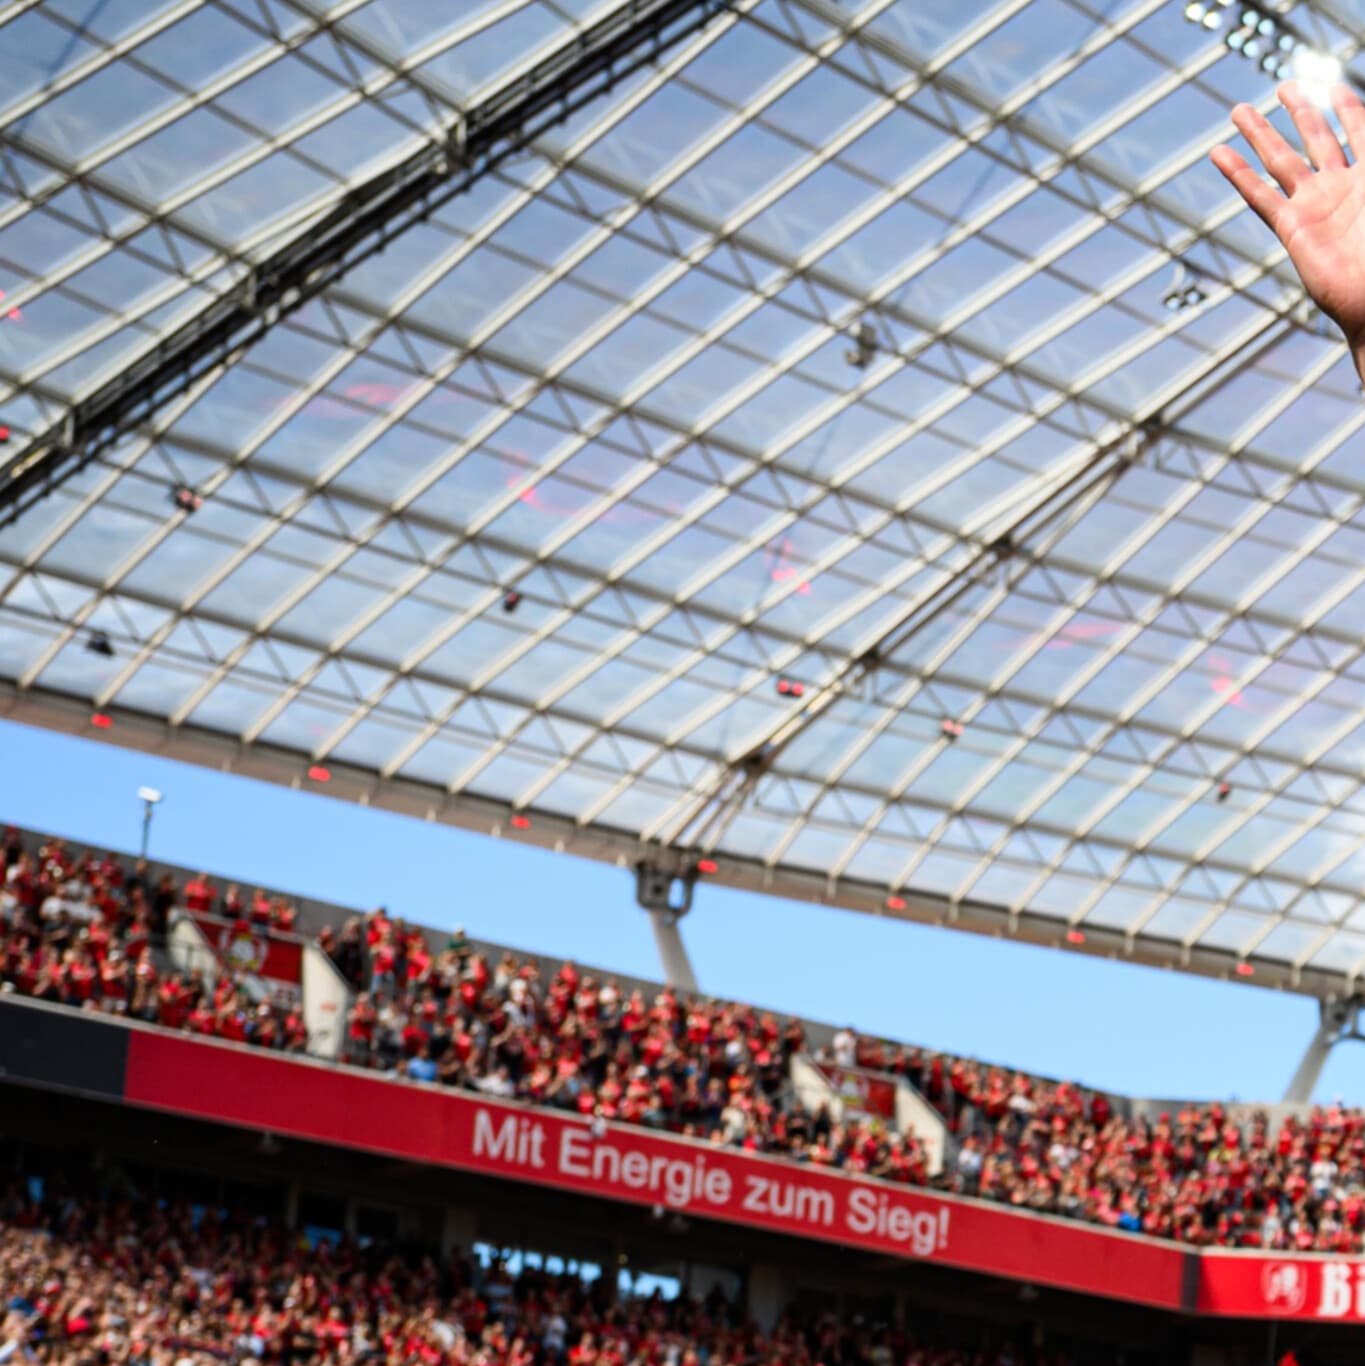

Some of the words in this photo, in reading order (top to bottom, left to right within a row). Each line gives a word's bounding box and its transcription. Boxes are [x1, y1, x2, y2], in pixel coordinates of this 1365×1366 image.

[472, 1109, 546, 1168] Mit
[557, 1127, 732, 1207] Energie
[742, 1175, 835, 1226] zum
[846, 1188, 951, 1256] Sieg!
